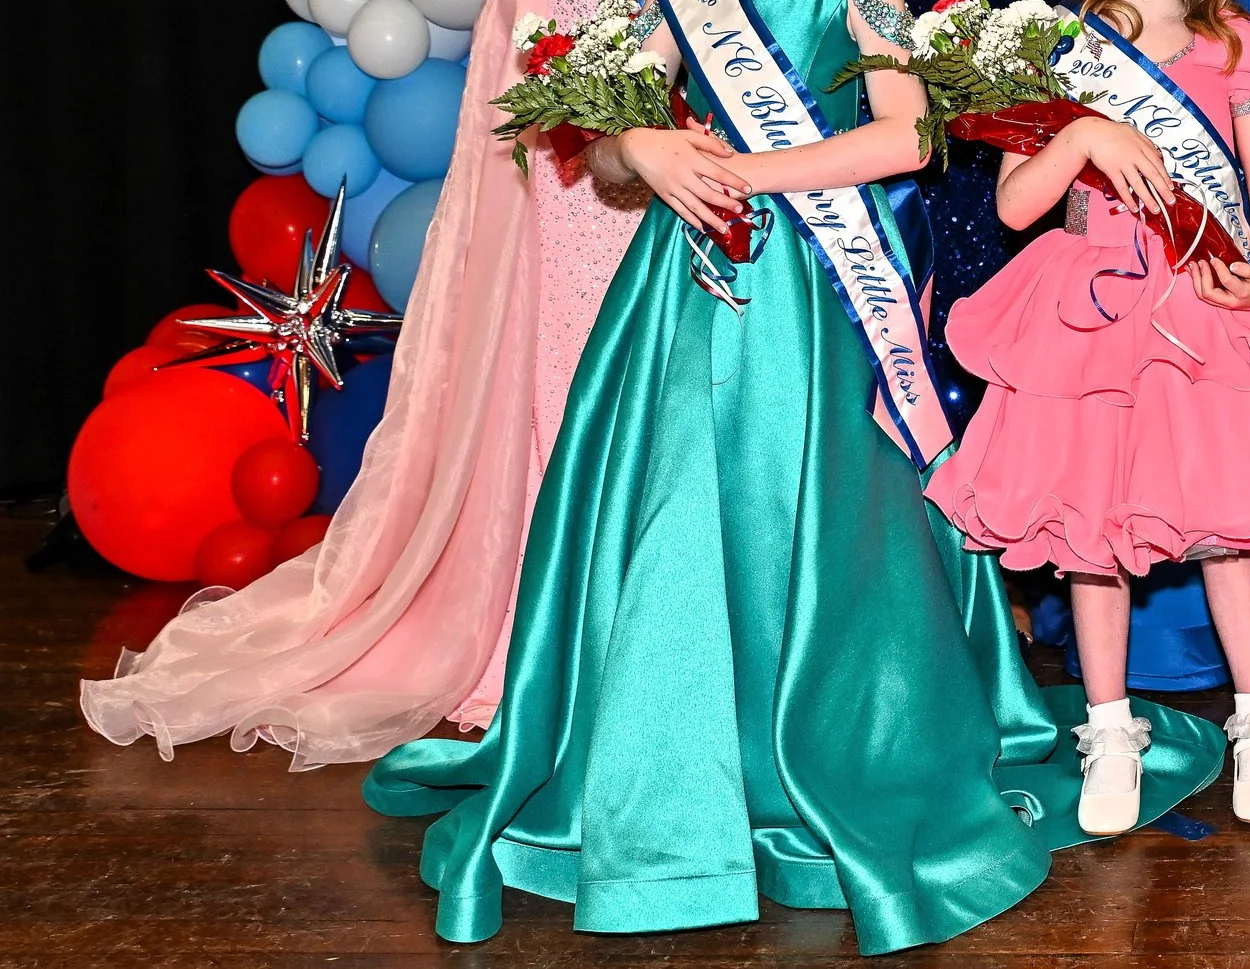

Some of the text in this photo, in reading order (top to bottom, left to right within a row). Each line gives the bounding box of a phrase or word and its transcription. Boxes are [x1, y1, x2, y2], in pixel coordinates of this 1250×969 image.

[1068, 59, 1117, 79] 2026
[1108, 93, 1182, 138] NC
[703, 20, 763, 79] NC
[836, 235, 898, 320] Little
[880, 326, 921, 407] Miss
